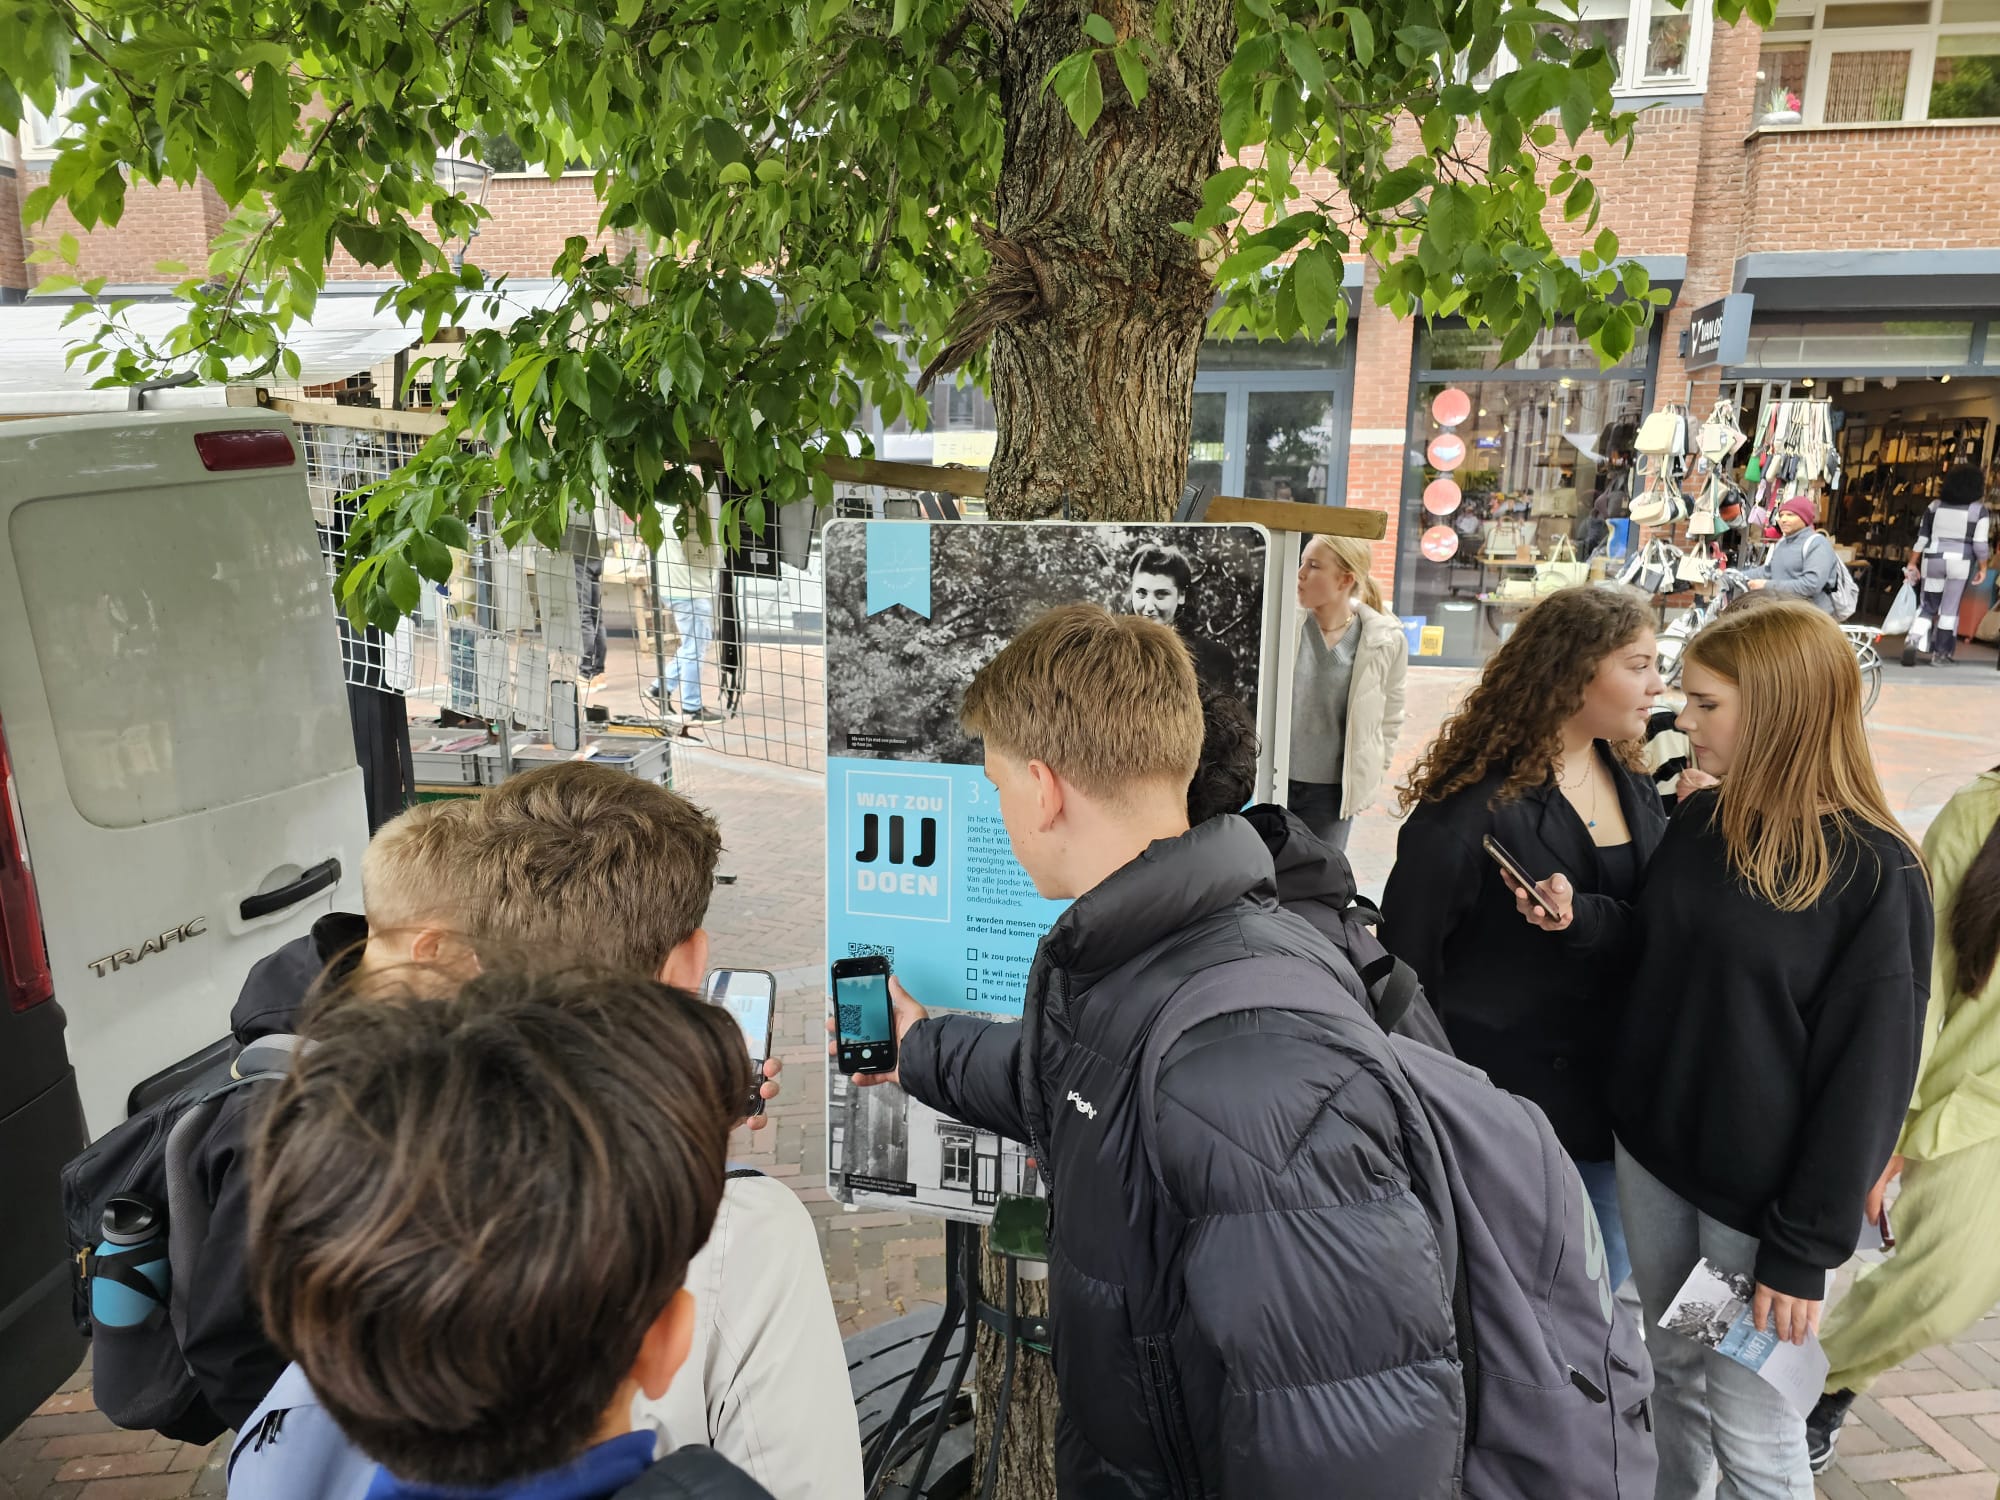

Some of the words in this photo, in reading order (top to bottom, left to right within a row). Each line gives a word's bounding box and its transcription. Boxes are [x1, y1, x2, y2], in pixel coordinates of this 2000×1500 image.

[856, 791, 899, 809] WAT
[904, 794, 944, 812] ZOU
[977, 816, 988, 824] het
[855, 813, 937, 868] JIJ
[982, 836, 994, 844] het
[967, 856, 1005, 866] vervolging
[967, 866, 1006, 876] opgesloten
[1008, 868, 1015, 876] in
[857, 869, 939, 897] DOEN
[982, 876, 995, 884] alle
[996, 878, 1021, 886] joodse
[966, 885, 980, 893] Van
[981, 886, 994, 896] Tijn
[996, 887, 1008, 895] het
[966, 914, 975, 922] Er
[975, 915, 1004, 925] worden
[1005, 919, 1036, 929] mensen
[966, 925, 988, 933] ander
[990, 926, 1007, 935] land
[1008, 928, 1035, 938] komen
[87, 915, 208, 979] TRAFIC
[981, 951, 989, 960] Ik
[991, 953, 1004, 961] zou
[982, 968, 990, 976] Ik
[991, 969, 1003, 977] wil
[1005, 970, 1021, 979] niet
[1006, 980, 1021, 988] niet
[981, 992, 989, 1000] Ik
[990, 993, 1007, 1002] vind
[1009, 994, 1021, 1003] het
